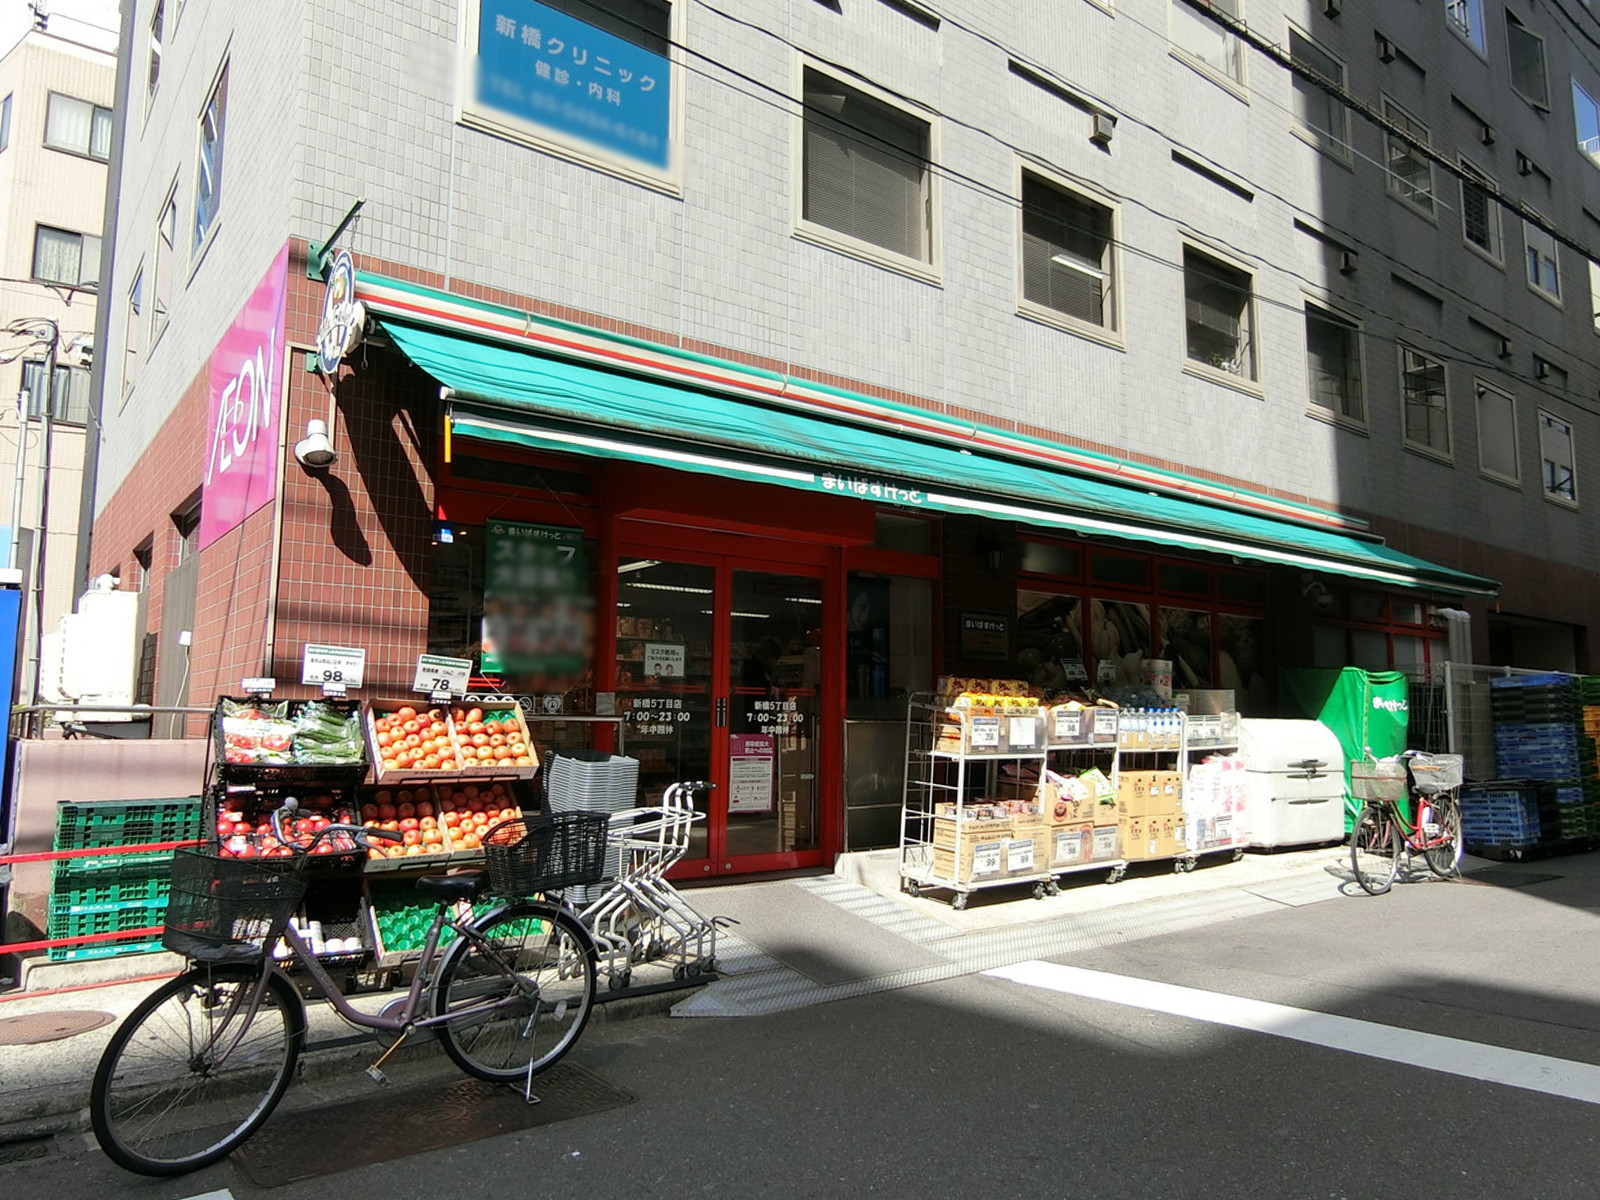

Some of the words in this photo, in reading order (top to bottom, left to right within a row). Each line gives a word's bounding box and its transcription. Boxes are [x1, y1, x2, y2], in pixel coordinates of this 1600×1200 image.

[495, 14, 656, 92] 新橋クリニック
[535, 60, 621, 106] 健診・内科
[820, 472, 923, 504] まいばすけっと
[323, 670, 343, 682] 98
[432, 678, 450, 691] 78
[633, 698, 682, 709] 新橋5丁目店
[754, 701, 797, 711] 新橋5丁目店
